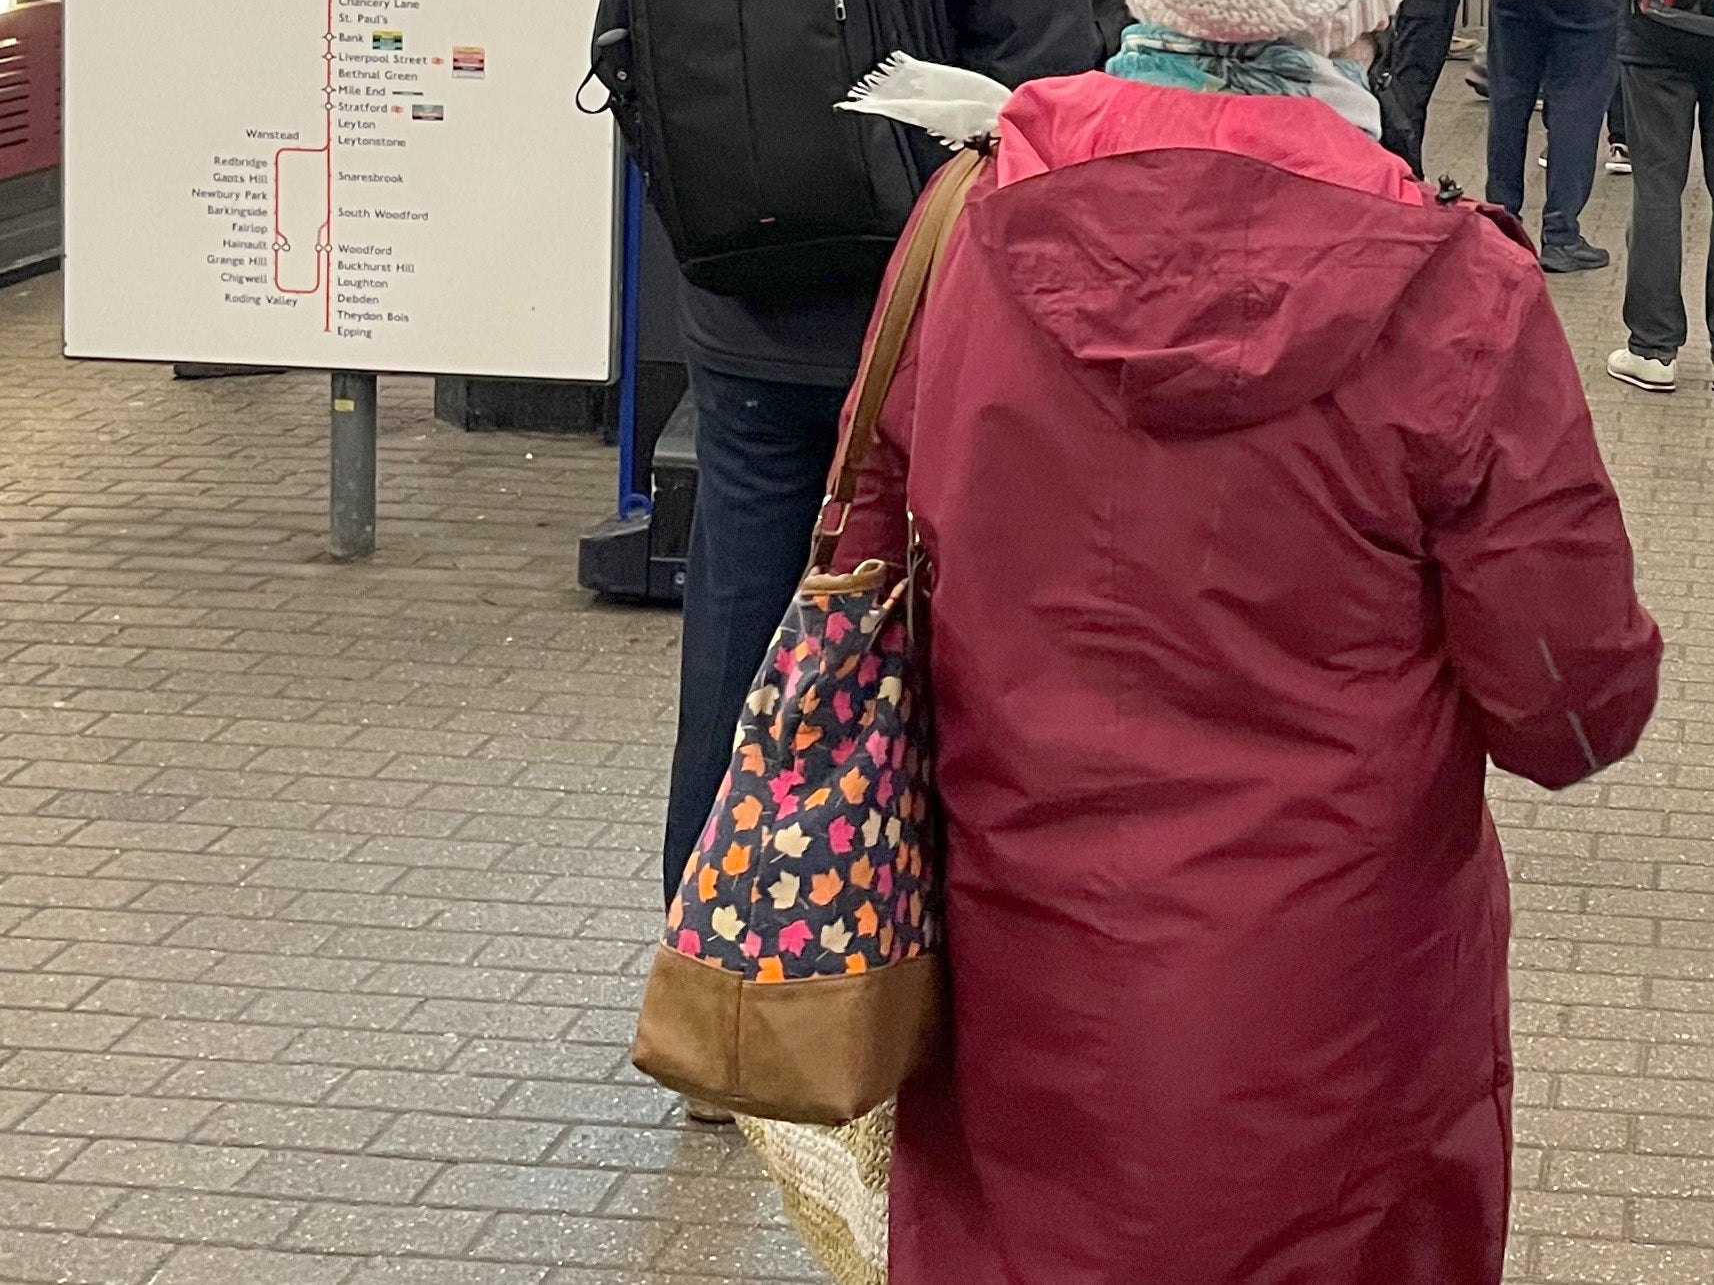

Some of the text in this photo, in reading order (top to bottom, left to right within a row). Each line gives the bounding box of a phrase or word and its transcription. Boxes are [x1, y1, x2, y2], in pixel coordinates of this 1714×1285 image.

[394, 0, 419, 9] Lane
[358, 15, 388, 24] Paul's
[339, 33, 363, 42] Bank
[339, 53, 428, 64] Liverpool Street
[339, 70, 418, 81] Bethnal Green
[339, 86, 361, 95] Mile
[338, 103, 387, 113] Stratford
[338, 119, 375, 130] Leyton
[246, 129, 299, 140] Wanstead
[338, 136, 406, 147] Leytonstone
[214, 157, 268, 168] Redbridge
[250, 174, 267, 183] Hill
[338, 172, 403, 183] Snaresbrook
[192, 189, 267, 201] Newbury Park
[207, 206, 268, 217] Barkingside
[338, 208, 429, 221] South Woodford
[338, 244, 392, 255] Woodford
[207, 255, 267, 267] Grange Hill
[338, 261, 415, 273] Buckhurst Hill
[221, 274, 267, 284] Chigwell
[338, 279, 388, 289] Loughton
[225, 294, 298, 307] Roding Valley
[338, 294, 379, 304] Debden
[338, 310, 383, 321] Theydon
[338, 327, 372, 339] Epping
